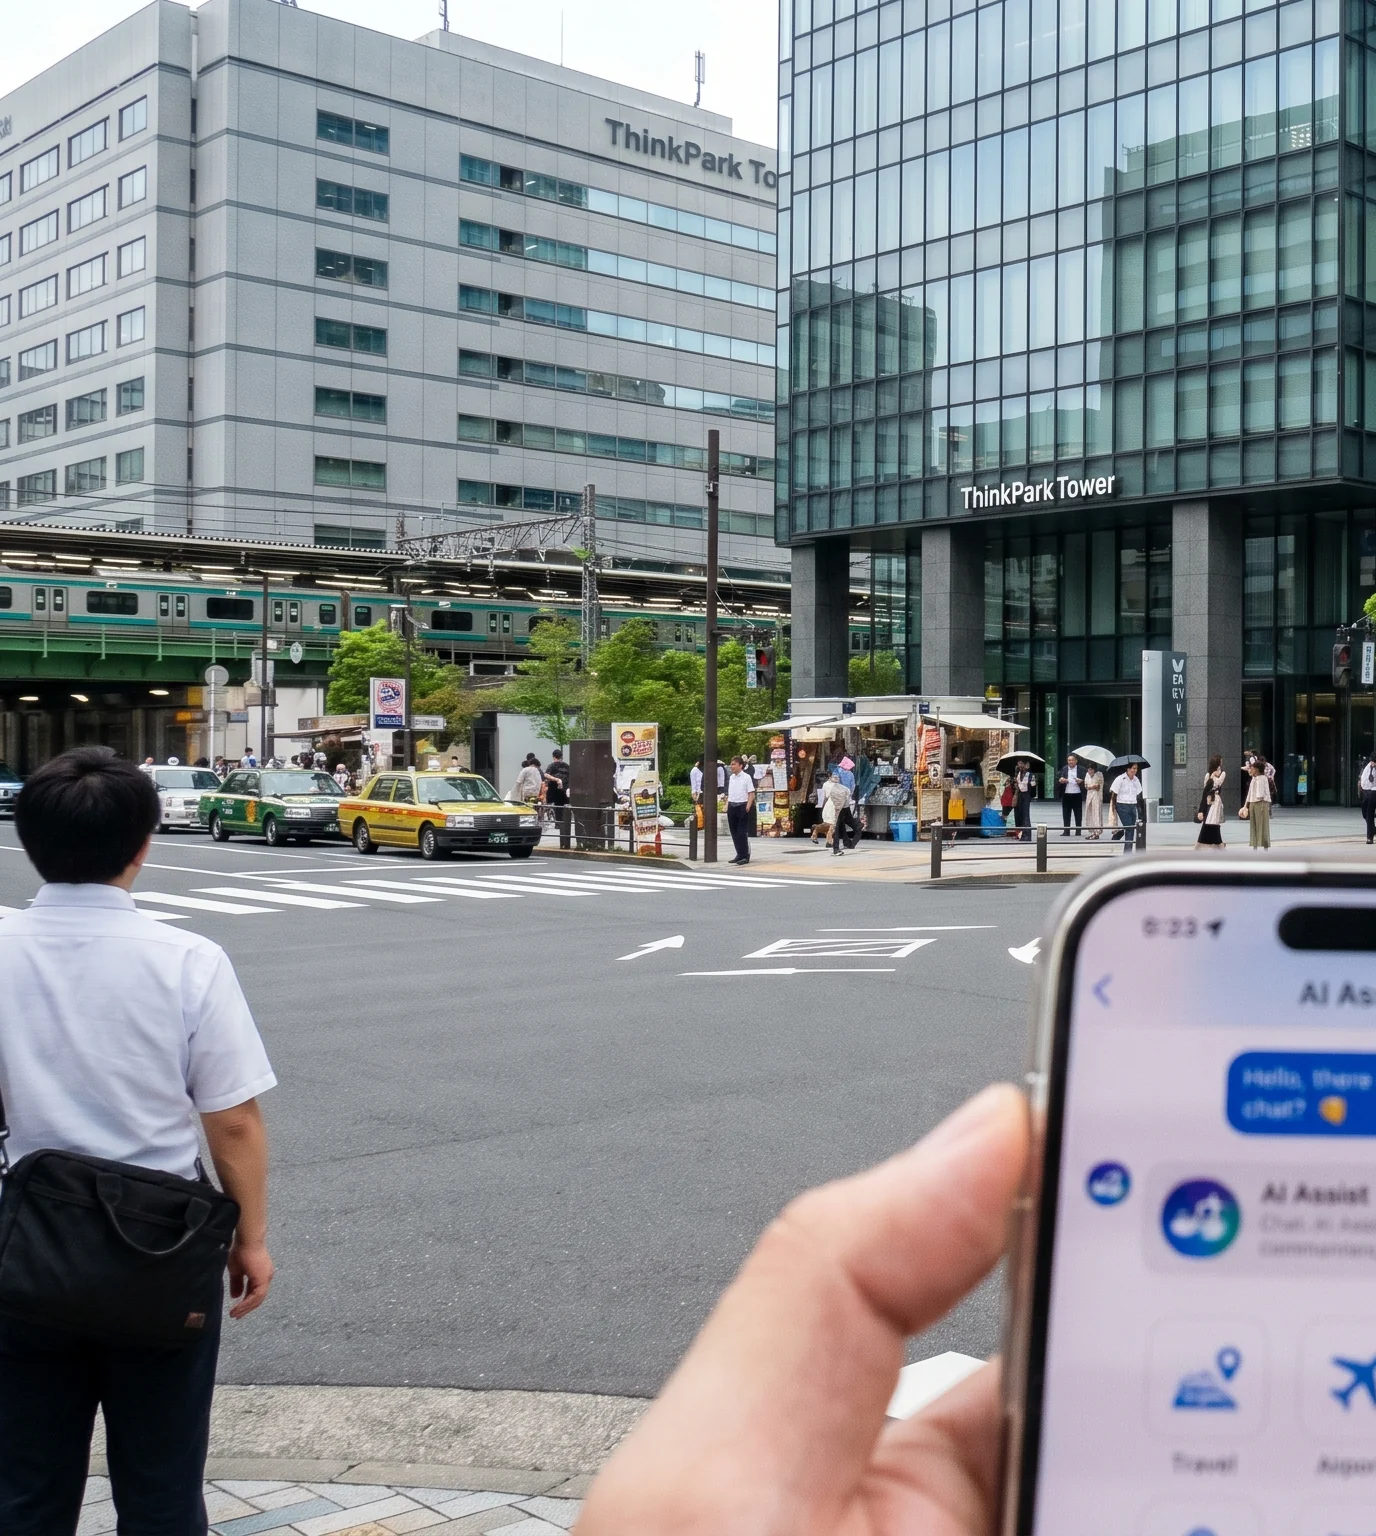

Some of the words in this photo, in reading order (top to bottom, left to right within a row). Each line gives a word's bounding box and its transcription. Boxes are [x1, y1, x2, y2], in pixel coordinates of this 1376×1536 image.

[605, 117, 742, 180] ThinkPark
[960, 478, 1054, 509] ThinkPark
[1056, 475, 1115, 499] Tower
[1300, 979, 1329, 1006] AI
[1294, 1181, 1369, 1206] Assist
[1173, 1452, 1238, 1476] Travel
